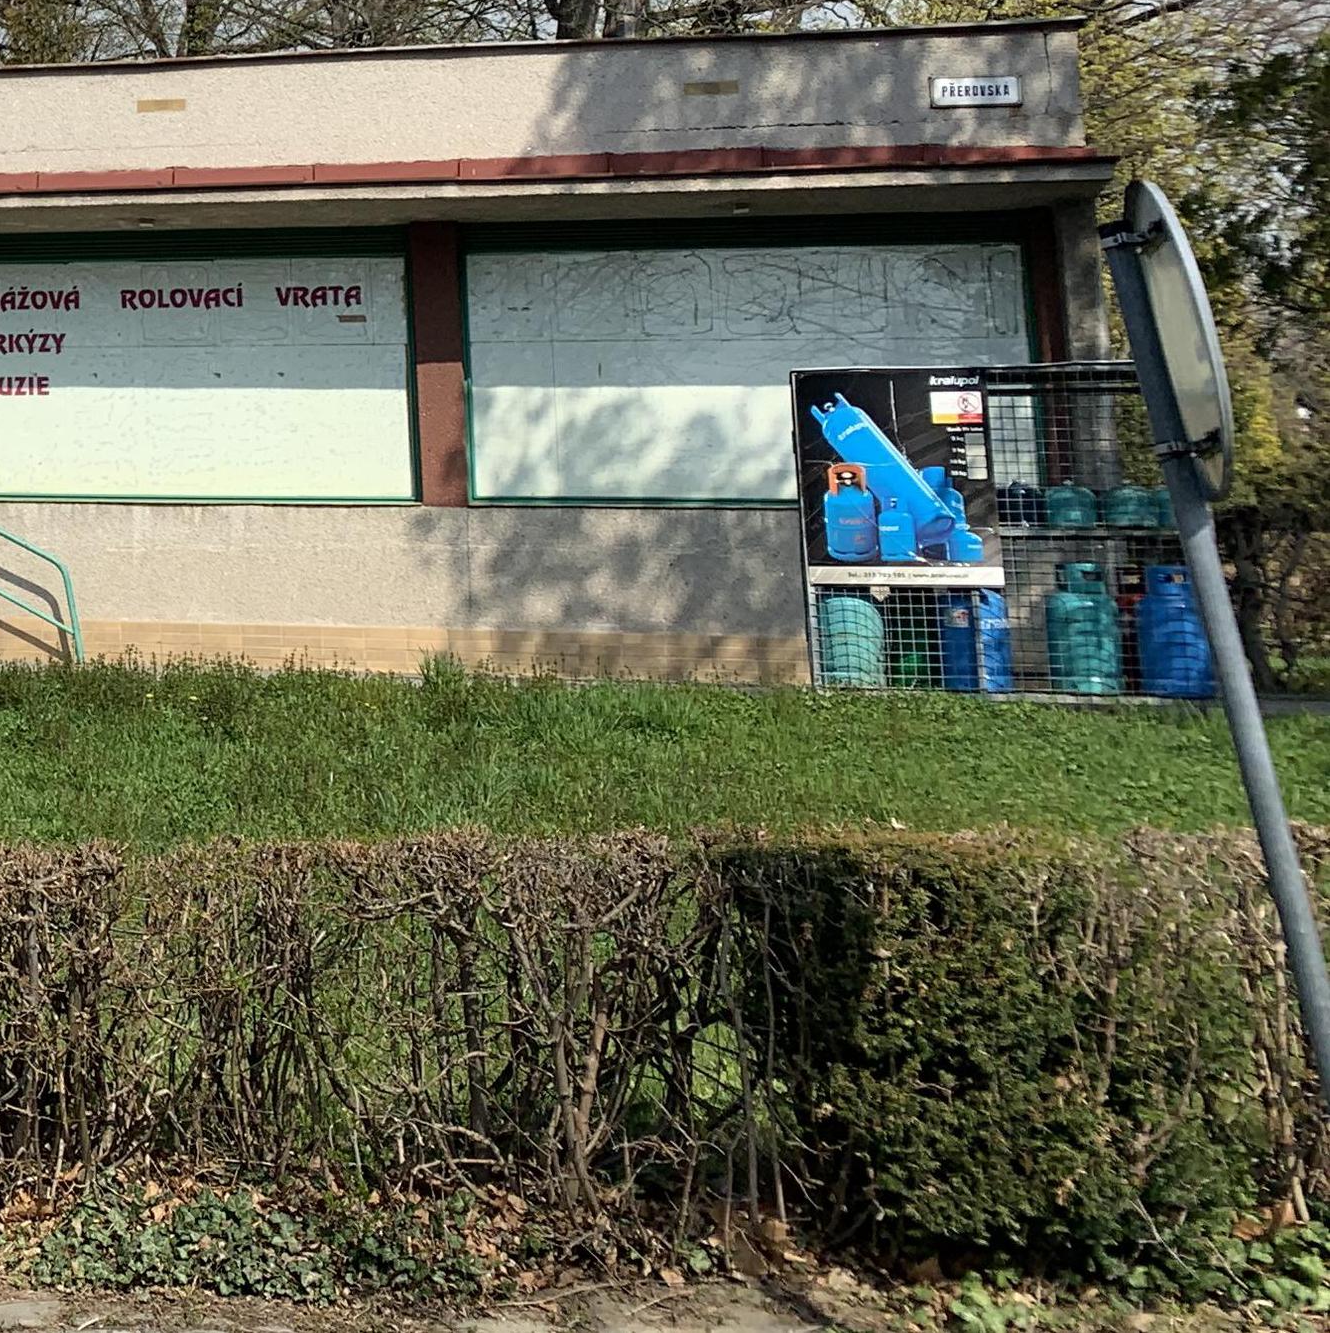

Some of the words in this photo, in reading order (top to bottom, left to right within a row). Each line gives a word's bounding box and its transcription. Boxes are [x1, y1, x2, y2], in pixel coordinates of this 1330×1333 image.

[121, 282, 244, 310] ROLOVACÍ
[275, 285, 362, 308] VRATA
[929, 375, 980, 387] kralupol
